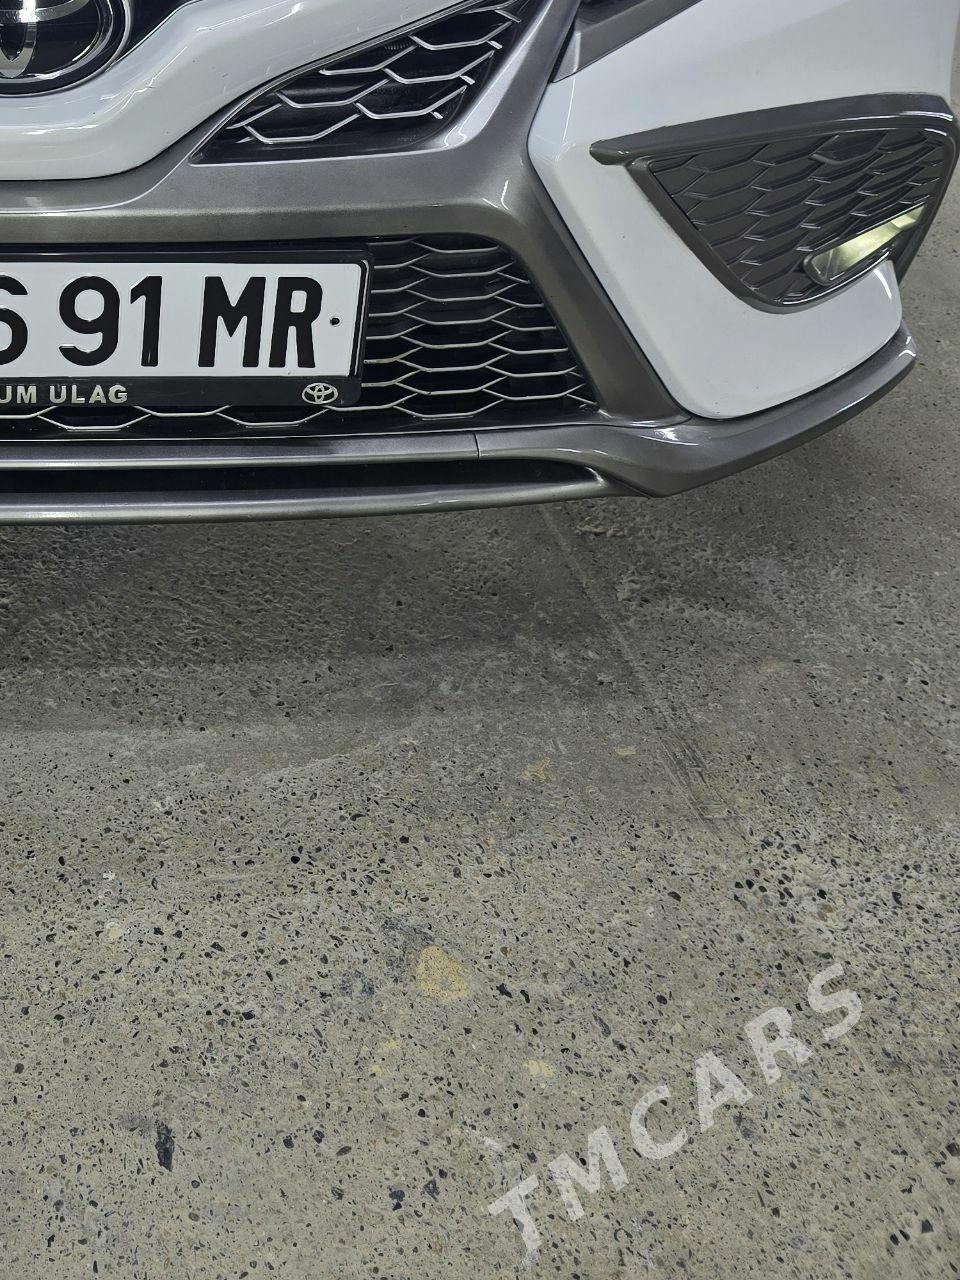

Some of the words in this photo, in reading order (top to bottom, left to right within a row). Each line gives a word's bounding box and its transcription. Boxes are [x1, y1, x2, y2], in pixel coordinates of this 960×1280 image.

[59, 275, 163, 367] 91
[198, 276, 323, 368] MR
[49, 384, 128, 404] ULAG
